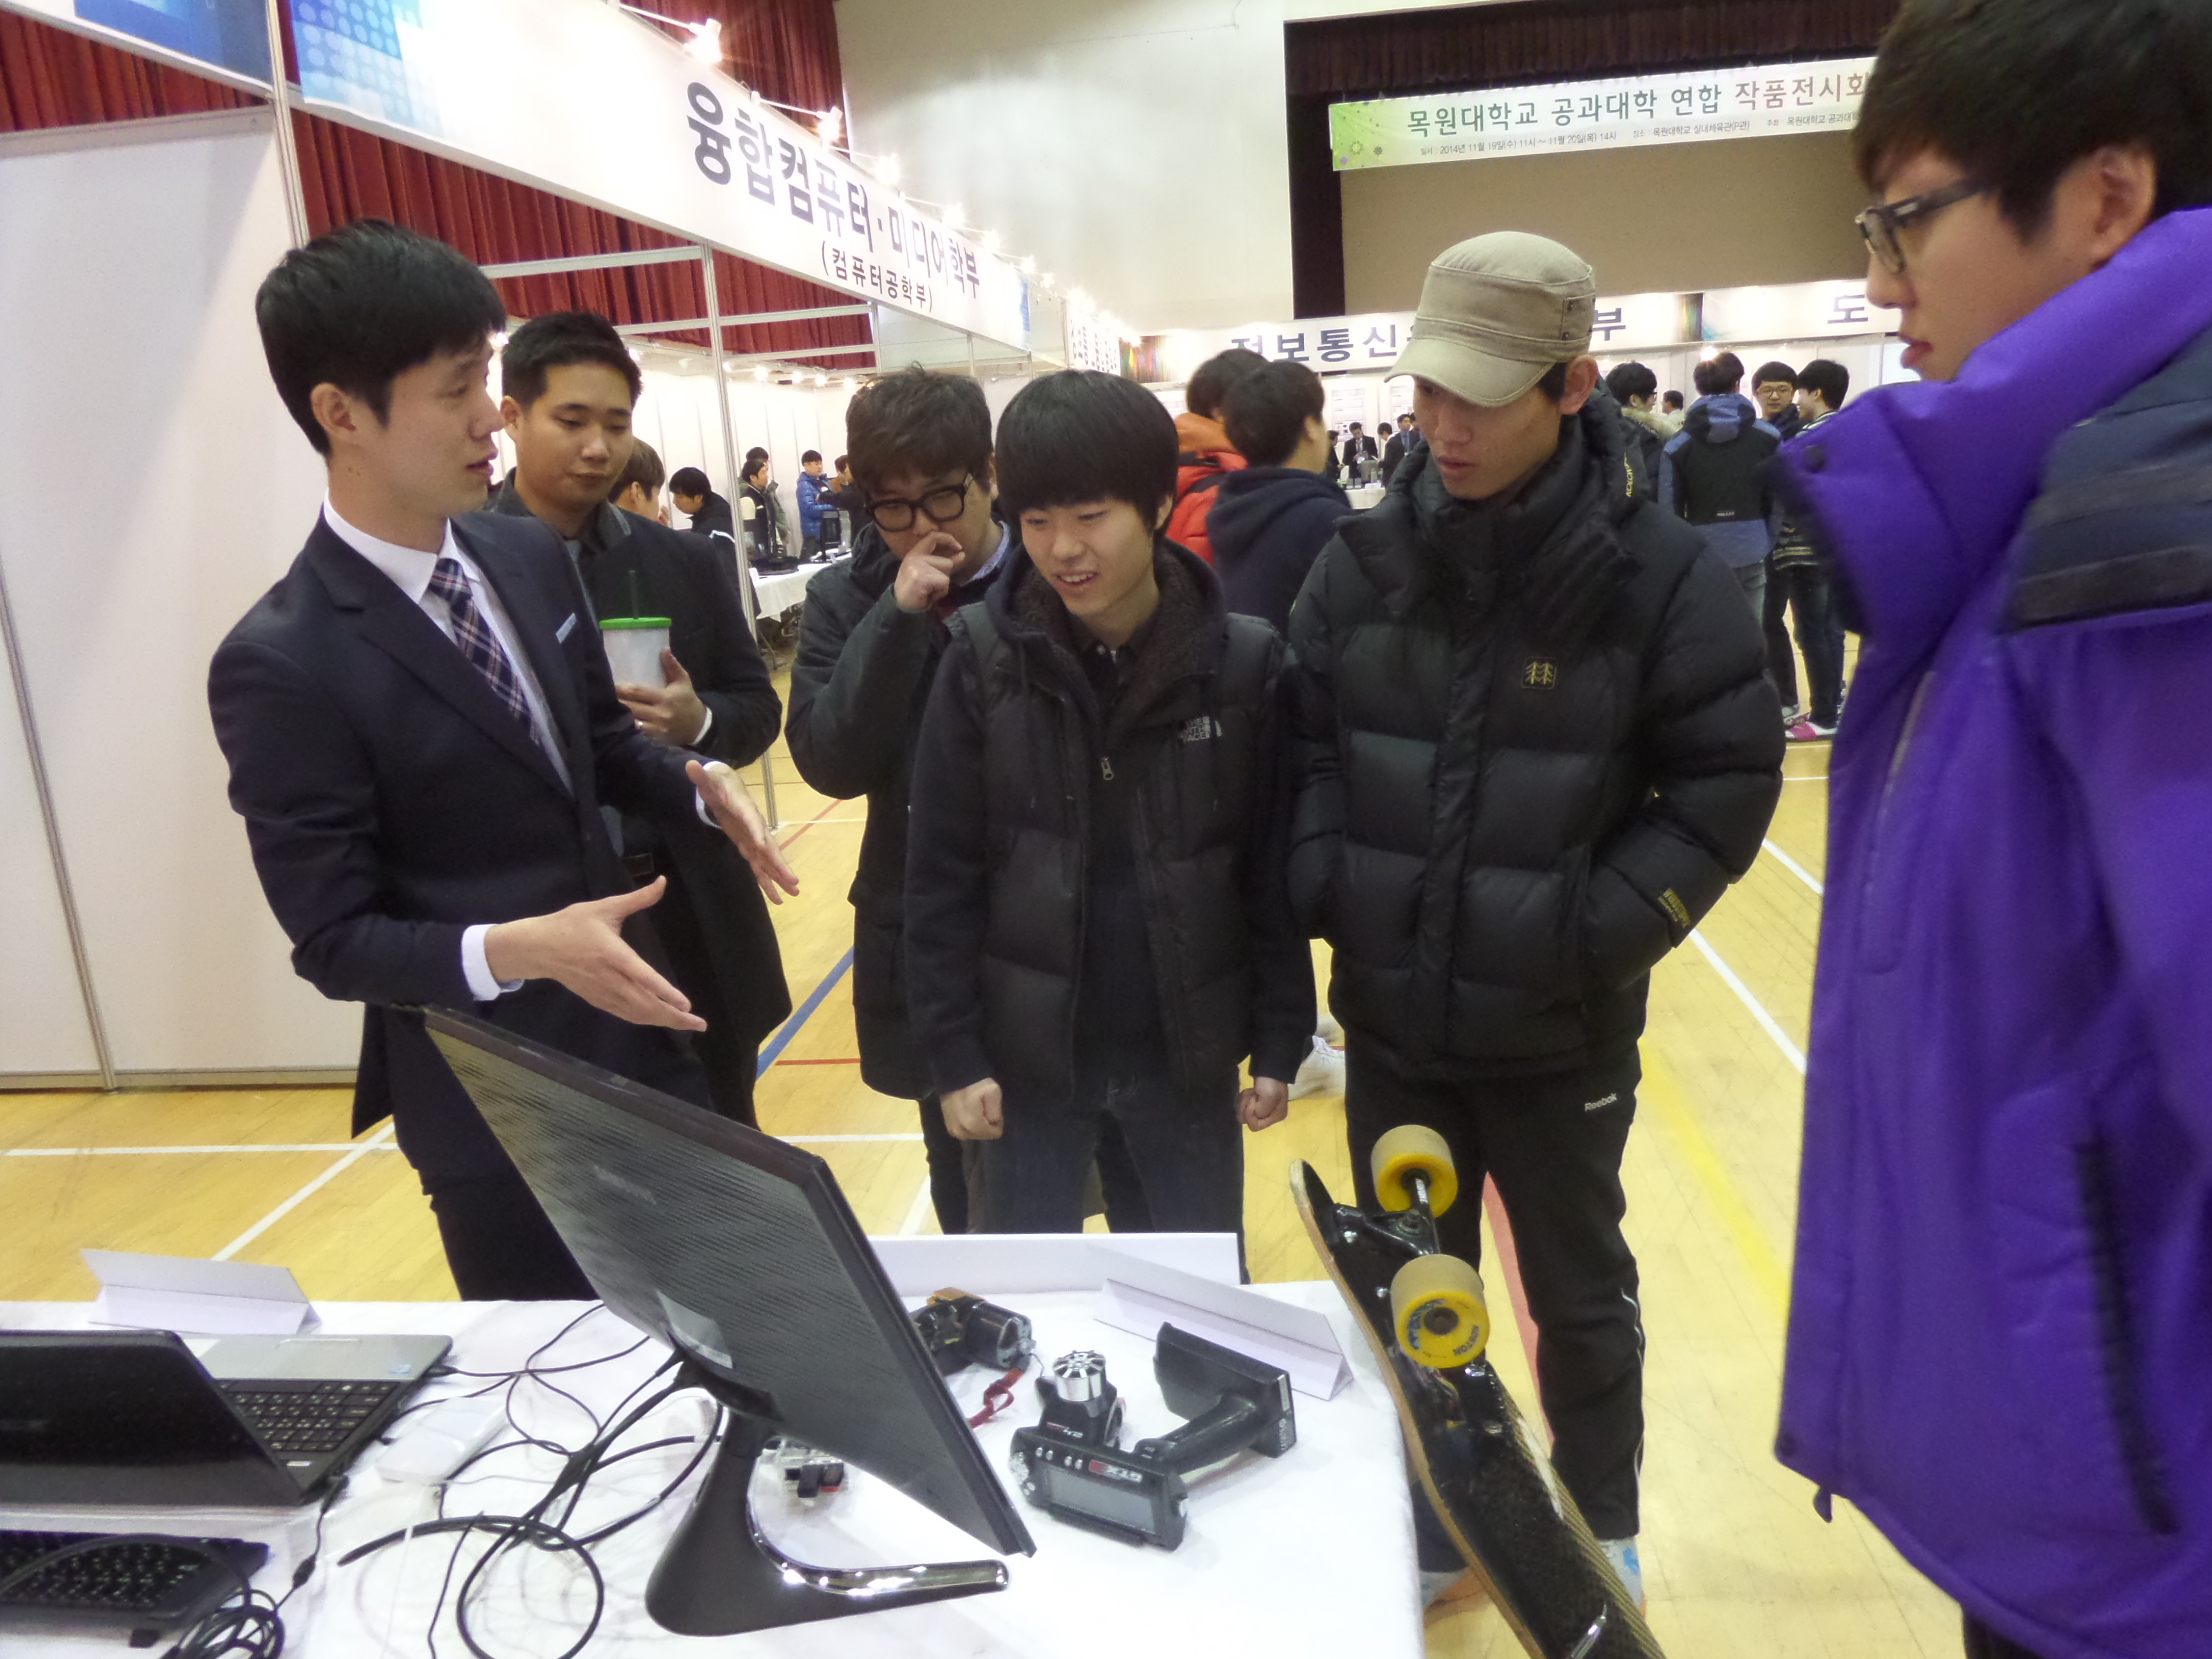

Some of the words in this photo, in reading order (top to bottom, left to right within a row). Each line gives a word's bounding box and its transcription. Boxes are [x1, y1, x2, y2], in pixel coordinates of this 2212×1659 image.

[1408, 101, 1538, 138] 목원대학교
[1551, 89, 1657, 126] 공과대학
[1671, 83, 1721, 116] 연합
[1440, 144, 1465, 154] 2014년
[1469, 141, 1484, 152] 11월
[1520, 137, 1536, 148] 11시
[1548, 135, 1565, 145] 11월
[1600, 131, 1617, 141] 14시
[821, 240, 932, 312] (컴퓨터공학부)
